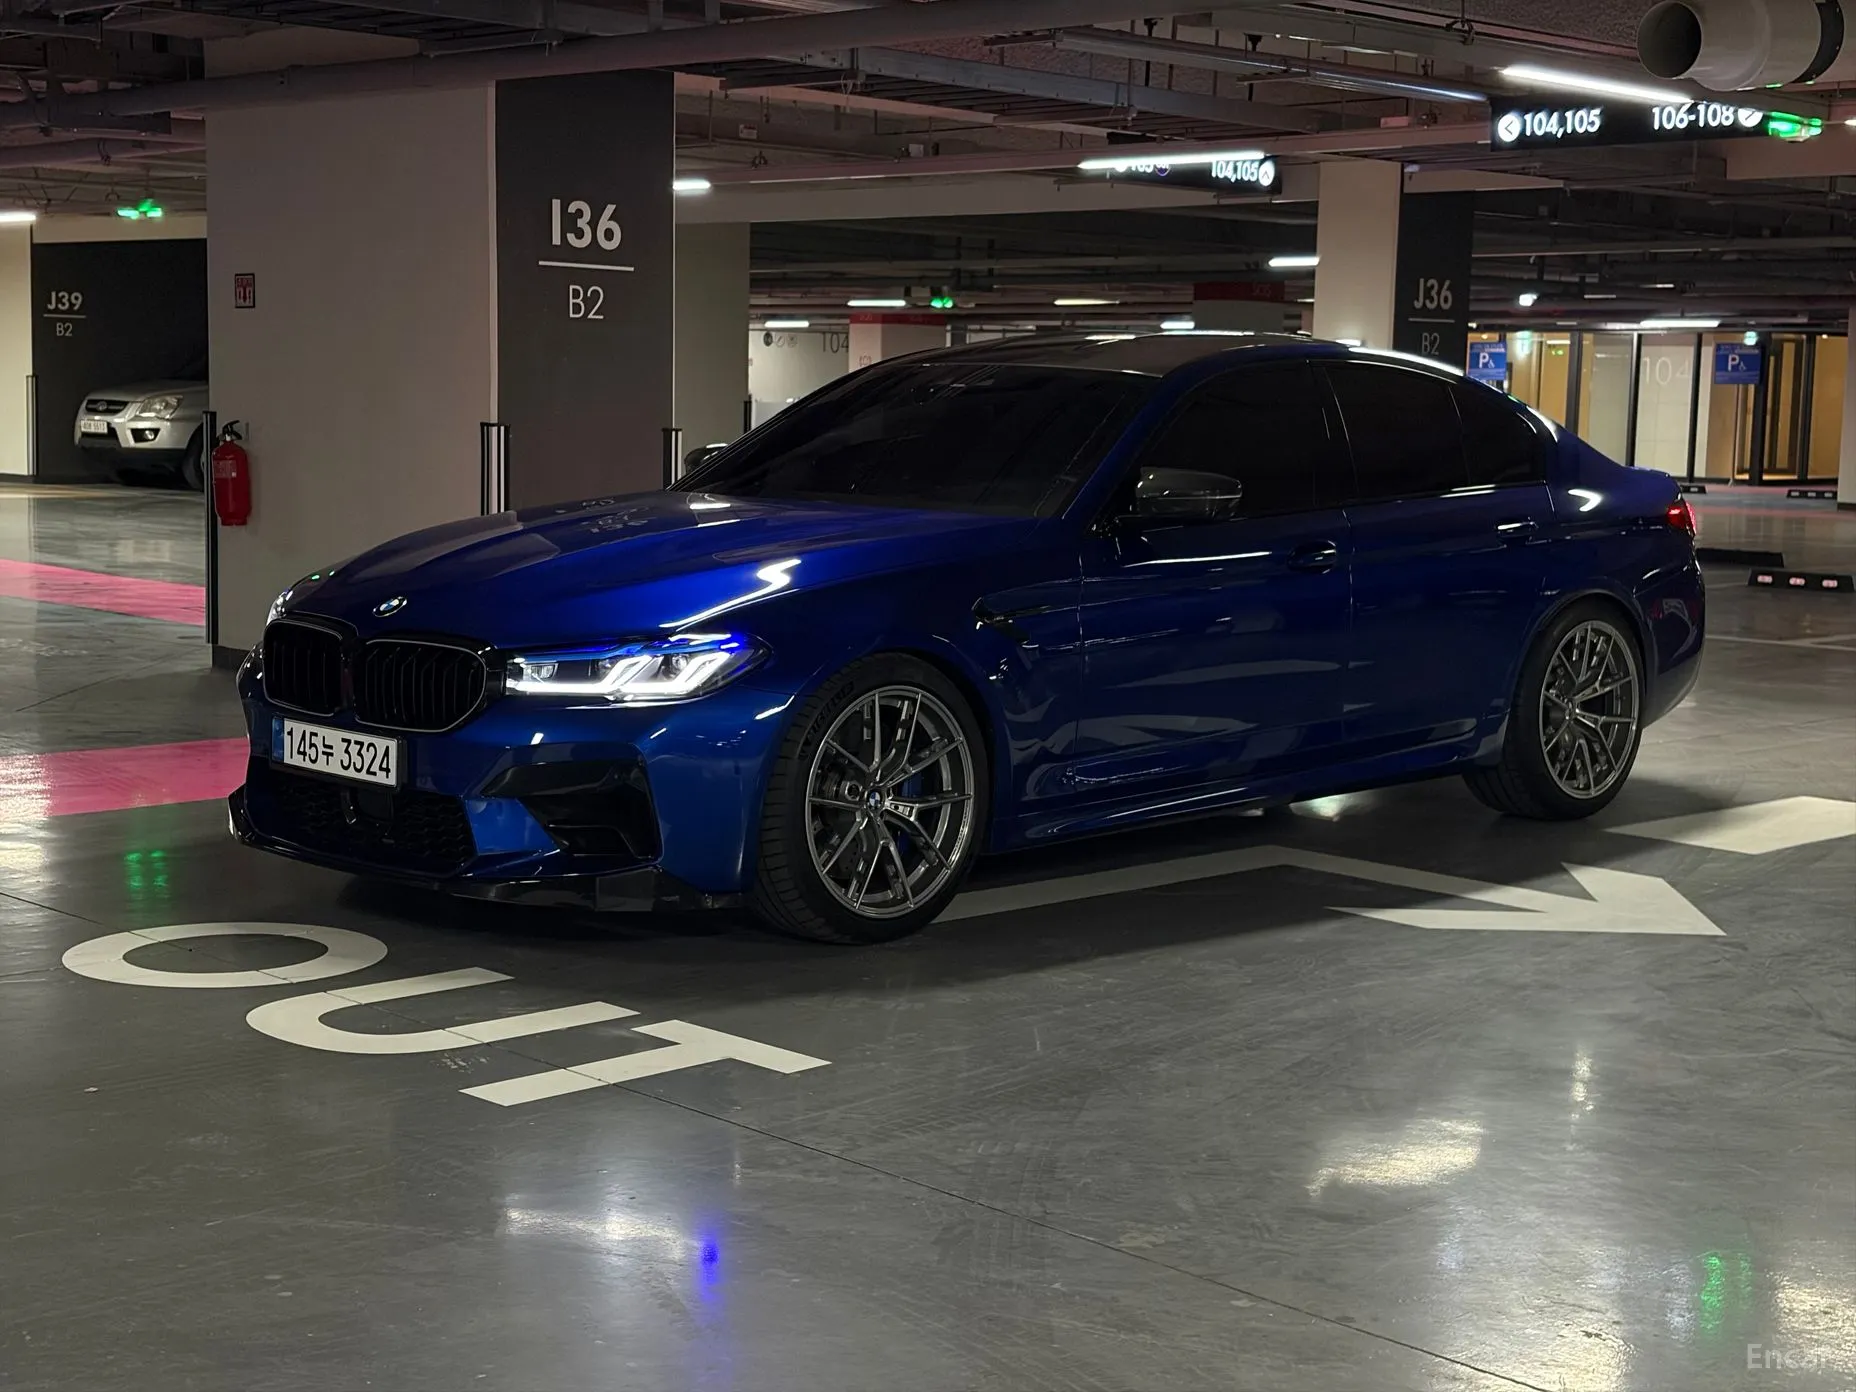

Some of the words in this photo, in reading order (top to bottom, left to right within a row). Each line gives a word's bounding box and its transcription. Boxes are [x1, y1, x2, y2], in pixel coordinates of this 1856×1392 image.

[1523, 109, 1601, 138] 104,105
[1651, 102, 1734, 130] 106-108
[1212, 158, 1259, 183] 104,105
[47, 291, 83, 310] J39
[569, 284, 604, 319] B2
[1413, 278, 1453, 310] J36
[56, 322, 73, 336] B2
[821, 331, 849, 353] 104
[1421, 333, 1440, 355] B2
[1479, 352, 1489, 368] P
[1642, 356, 1690, 385] 104
[1728, 354, 1739, 371] P
[286, 726, 334, 766] 145누
[340, 737, 392, 779] 3324
[61, 921, 833, 1107] OUT
